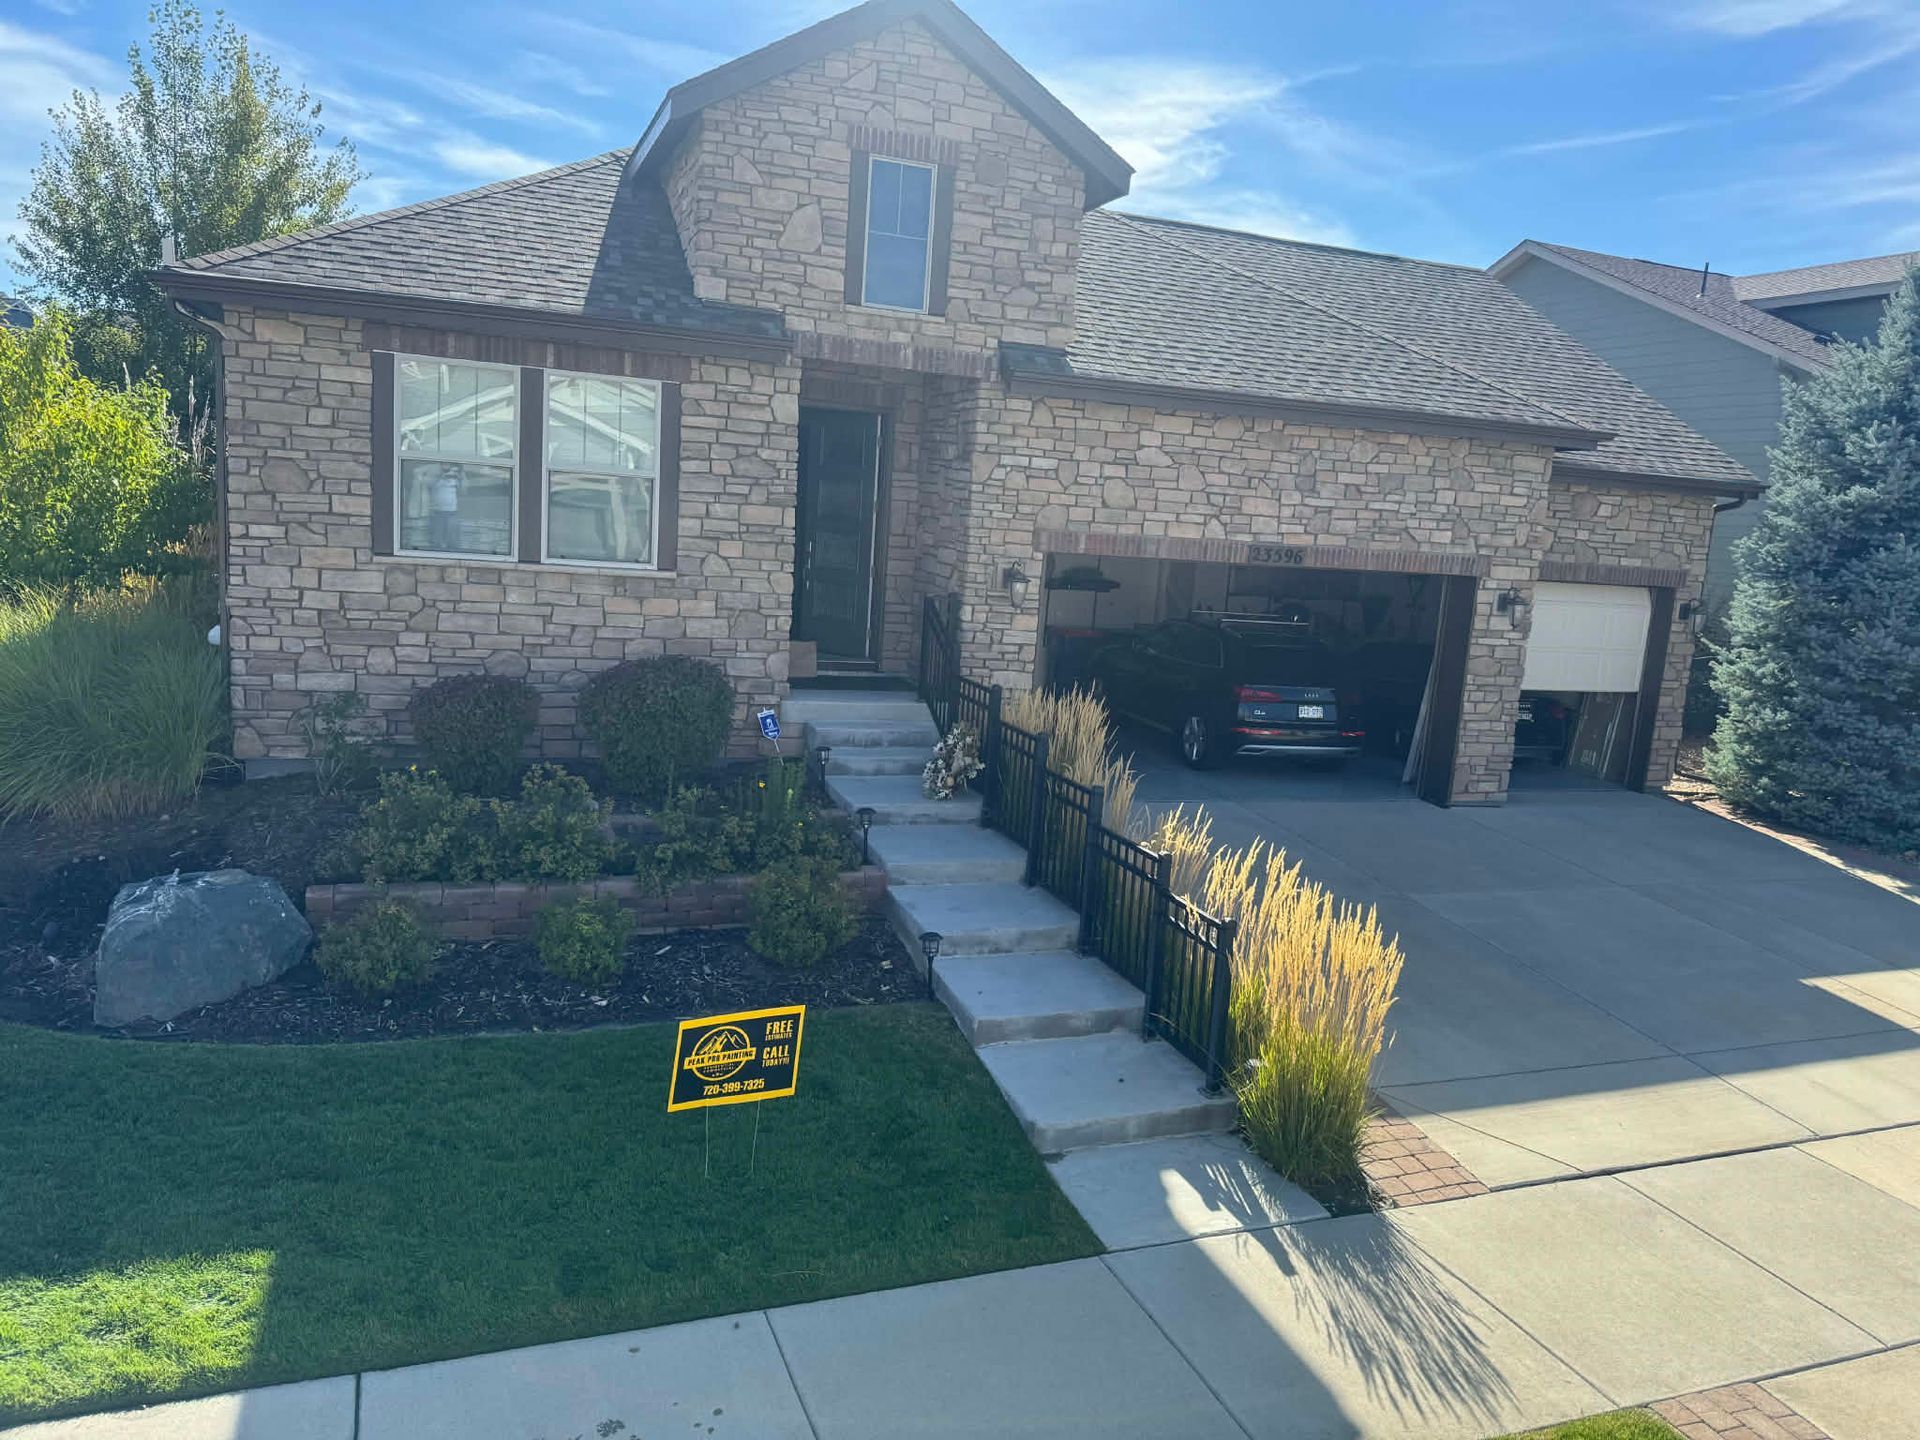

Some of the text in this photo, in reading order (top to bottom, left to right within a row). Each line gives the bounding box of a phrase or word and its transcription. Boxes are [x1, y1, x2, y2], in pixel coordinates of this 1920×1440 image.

[766, 1020, 794, 1034] FREE
[688, 1055, 705, 1067] PEAK
[707, 1053, 719, 1064] PRO
[722, 1049, 754, 1061] PAINTING
[763, 1044, 790, 1059] CALL
[703, 1078, 765, 1096] 720-399-7325
